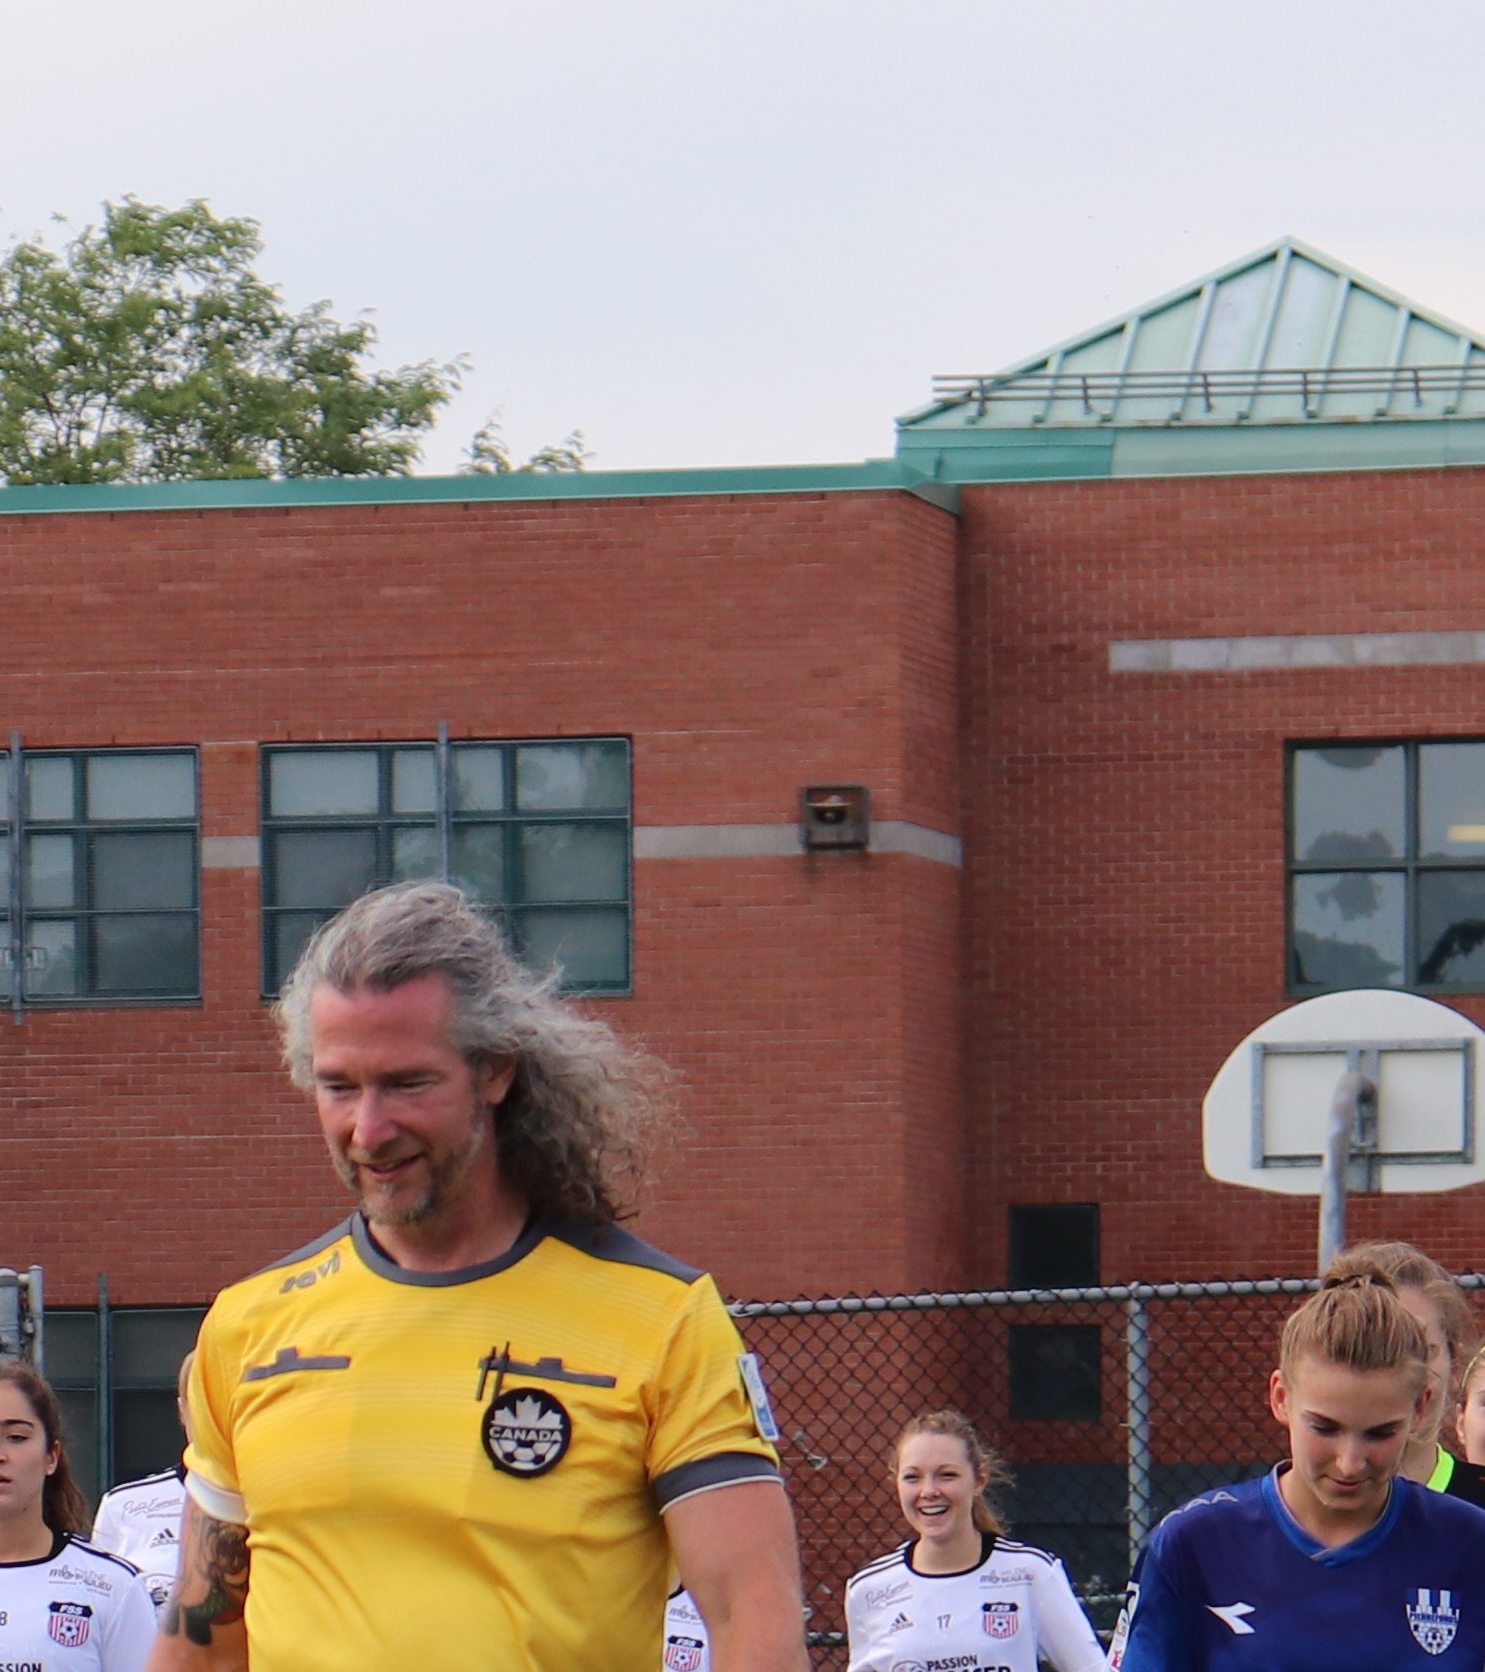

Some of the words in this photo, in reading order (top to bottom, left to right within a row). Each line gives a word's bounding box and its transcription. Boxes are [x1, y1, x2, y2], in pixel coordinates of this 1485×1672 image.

[278, 1251, 339, 1295] savi
[489, 1426, 562, 1443] CANADA
[59, 1605, 83, 1615] FSS
[936, 1614, 952, 1630] 17
[927, 1655, 978, 1672] PASSION
